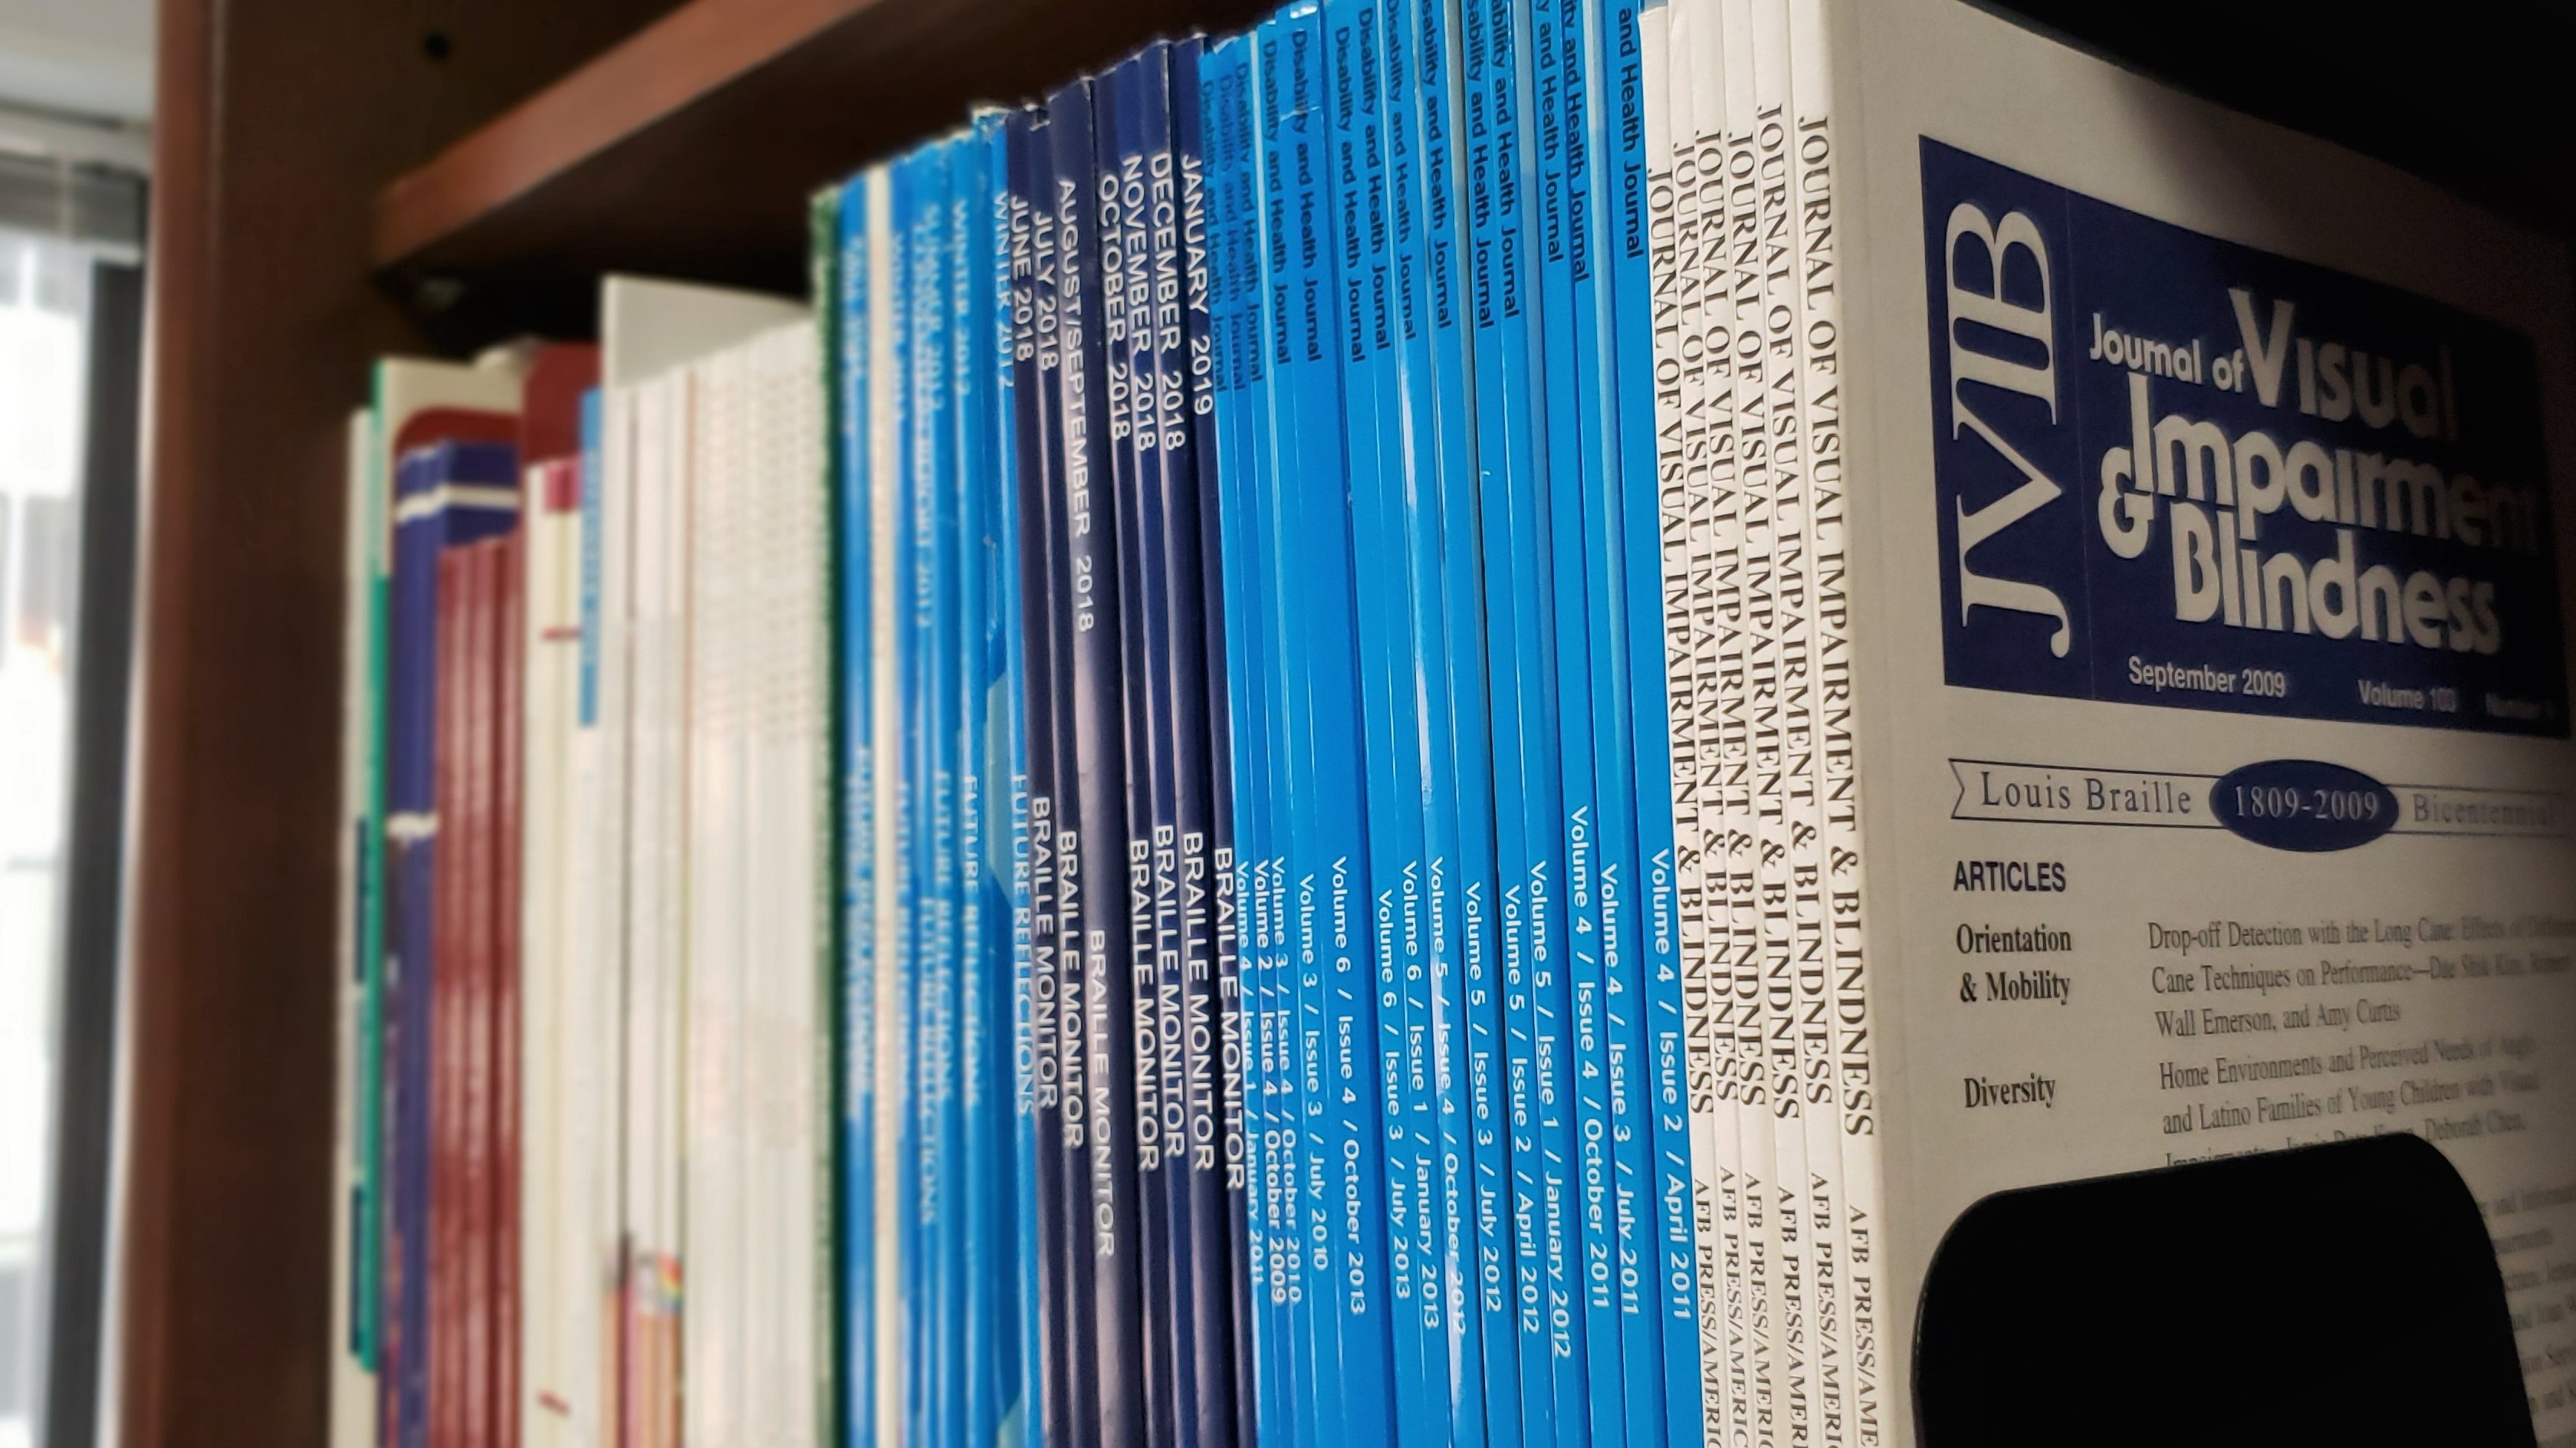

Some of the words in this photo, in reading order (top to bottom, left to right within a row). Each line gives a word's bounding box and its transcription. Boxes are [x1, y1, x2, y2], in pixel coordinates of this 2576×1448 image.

[1565, 38, 1582, 87] and
[1618, 8, 1637, 57] and
[1335, 26, 1352, 131] Disability
[1621, 64, 1640, 152] Health
[1342, 142, 1356, 184] and
[1568, 92, 1585, 179] Health
[1010, 195, 1032, 281] JUNE
[1181, 155, 1209, 314] JANUARY
[1344, 190, 1361, 268] Health
[1572, 188, 1589, 282] Journal
[1624, 160, 1644, 258] Journal
[1673, 142, 1701, 325] JOURNAL
[1696, 129, 1730, 317] JOURNAL
[1728, 133, 1760, 320] JOURNAL
[1757, 103, 1792, 294] JOURNAL
[1799, 117, 1835, 310] JOURNAL
[1033, 211, 1055, 286] JULY
[1099, 174, 1126, 346] OCTOBER
[1122, 154, 1152, 355] NOVEMBER
[1150, 153, 1181, 354] DECEMBER
[1647, 169, 1677, 348] JOURNAL
[1013, 288, 1034, 362] 2018
[1037, 296, 1059, 370] 2018
[1348, 277, 1365, 363] Journal
[1682, 334, 1704, 386] OF
[1704, 326, 1730, 379] OF
[1736, 329, 1762, 383] OF
[1768, 304, 1793, 358] OF
[1808, 320, 1837, 375] OF
[2090, 312, 2202, 384] Journal
[1059, 180, 1090, 537] AUGUST/SEPTEMBER
[1076, 555, 1093, 632] 2018
[1110, 362, 1131, 442] 2018
[1191, 335, 1214, 415] 2019
[1655, 357, 1681, 410] OF
[2213, 349, 2244, 392] of
[2228, 287, 2458, 443] Visual
[1134, 373, 1157, 451] 2018
[1162, 371, 1185, 450] 2018
[1771, 369, 1799, 521] VISUAL
[1945, 202, 2070, 658] JVIB
[1660, 420, 1686, 562] VISUAL
[1686, 396, 1710, 542] VISUAL
[1709, 388, 1737, 537] VISUAL
[1741, 394, 1769, 543] VISUAL
[1811, 386, 1842, 540] VISUAL
[2098, 447, 2154, 559] &
[2170, 529, 2501, 655] Blindness
[1665, 573, 1698, 832] IMPAIRMENT
[1691, 553, 1723, 816] IMPAIRMENT
[1715, 546, 1750, 816] IMPAIRMENT
[1747, 552, 1783, 825] IMPAIRMENT
[1778, 529, 1813, 806] IMPAIRMENT
[1818, 550, 1855, 831] IMPAIRMENT
[2128, 656, 2235, 693] September
[2242, 668, 2285, 698] 2009
[2358, 679, 2423, 710] Volume
[1011, 774, 1031, 898] FUTURE
[1792, 820, 1816, 850] &
[1980, 771, 2071, 809] Louis
[2084, 777, 2191, 813] Braille
[2235, 785, 2378, 821] 1809-2009
[1033, 796, 1053, 936] BRAILLE
[1678, 846, 1700, 873] &
[1704, 829, 1724, 858] &
[1727, 829, 1752, 858] &
[1761, 839, 1785, 868] &
[1831, 847, 1858, 877] &
[1953, 861, 2066, 891] ARTICLES
[1059, 831, 1080, 971] BRAILLE
[1129, 839, 1154, 985] BRAILLE
[1155, 825, 1178, 971] BRAILLE
[1183, 832, 1208, 983] BRAILLE
[1214, 848, 1237, 997] BRAILLE
[1378, 889, 1394, 983] Volume
[1602, 863, 1619, 967] Volume
[1652, 849, 1671, 954] Volume
[1957, 924, 2072, 954] Orientation
[2148, 921, 2221, 955] Drop-off
[2229, 921, 2302, 947] Detection
[2308, 921, 2341, 944] with
[2346, 920, 2368, 943] the
[2374, 919, 2411, 948] Long
[1089, 931, 1109, 1075] BRAILLE
[1383, 992, 1397, 1007] 6
[1607, 977, 1623, 995] 4
[1657, 964, 1674, 982] 4
[1680, 888, 1714, 1112] BLINDNESS
[1705, 871, 1737, 1100] BLINDNESS
[1730, 871, 1765, 1105] BLINDNESS
[1763, 881, 1799, 1118] BLINDNESS
[1794, 864, 1832, 1104] BLINDNESS
[1832, 891, 1874, 1135] BLINDNESS
[1960, 973, 1977, 1003] &
[1986, 970, 2070, 1005] Mobility
[2152, 966, 2194, 993] Cane
[2201, 964, 2291, 996] Techniques
[2296, 969, 2315, 987] on
[1036, 947, 1058, 1110] MONITOR
[2155, 1009, 2196, 1036] Wall
[2201, 1008, 2276, 1035] Emerson,
[2283, 1004, 2310, 1029] and
[2317, 1003, 2351, 1032] Amy
[1063, 983, 1084, 1148] MONITOR
[1136, 999, 1159, 1171] MONITOR
[1161, 984, 1185, 1157] MONITOR
[1189, 994, 1214, 1171] MONITOR
[1221, 1012, 1245, 1190] MONITOR
[1386, 1052, 1401, 1115] Issue
[1610, 1044, 1628, 1115] Issue
[1660, 1033, 1678, 1104] Issue
[1963, 1073, 2055, 1108] Diversity
[2160, 1062, 2210, 1089] Home
[2216, 1054, 2322, 1084] Environments
[2329, 1047, 2354, 1072] and
[2359, 1041, 2429, 1069] Perceived
[1388, 1125, 1403, 1140] 3
[1613, 1125, 1631, 1142] 3
[1664, 1115, 1683, 1131] 2
[2164, 1105, 2193, 1134] and
[2199, 1101, 2252, 1131] Latino
[2256, 1092, 2321, 1123] Families
[2327, 1088, 2343, 1115] of
[2348, 1085, 2395, 1114] Young
[1094, 1086, 1115, 1257] MONITOR
[1391, 1177, 1407, 1227] July
[1616, 1183, 1635, 1240] July
[1664, 1173, 1688, 1243] April
[1695, 1178, 1711, 1233] AFB
[1720, 1166, 1737, 1221] AFB
[1745, 1173, 1762, 1228] AFB
[1811, 1172, 1830, 1230] AFB
[1778, 1186, 1797, 1243] AFB
[1849, 1205, 1870, 1263] AFB
[1394, 1236, 1411, 1299] 2013
[1620, 1249, 1640, 1315] 2011
[1671, 1252, 1691, 1319] 2011
